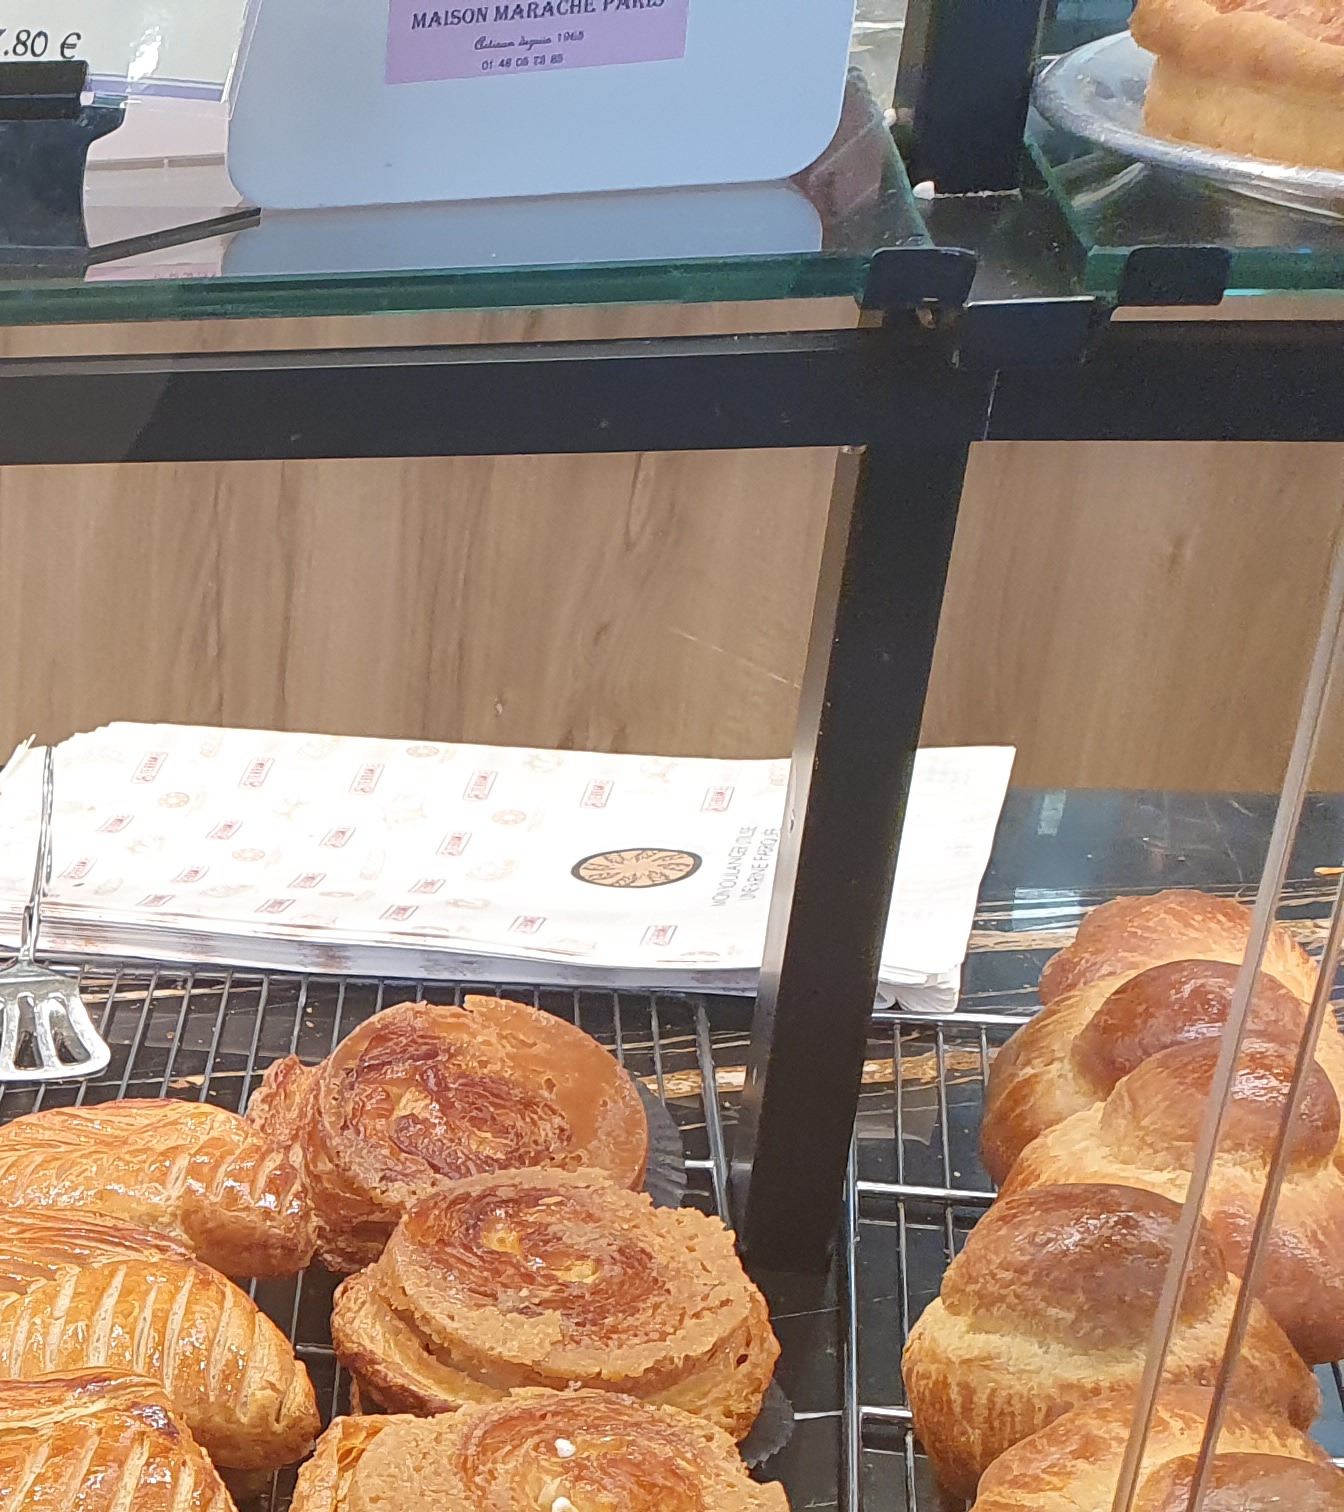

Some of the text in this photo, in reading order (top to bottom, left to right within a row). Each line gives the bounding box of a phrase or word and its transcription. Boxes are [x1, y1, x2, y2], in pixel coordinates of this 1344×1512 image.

[412, 7, 489, 29] MAISON
[493, 0, 597, 22] MARACHE
[60, 32, 82, 59] €
